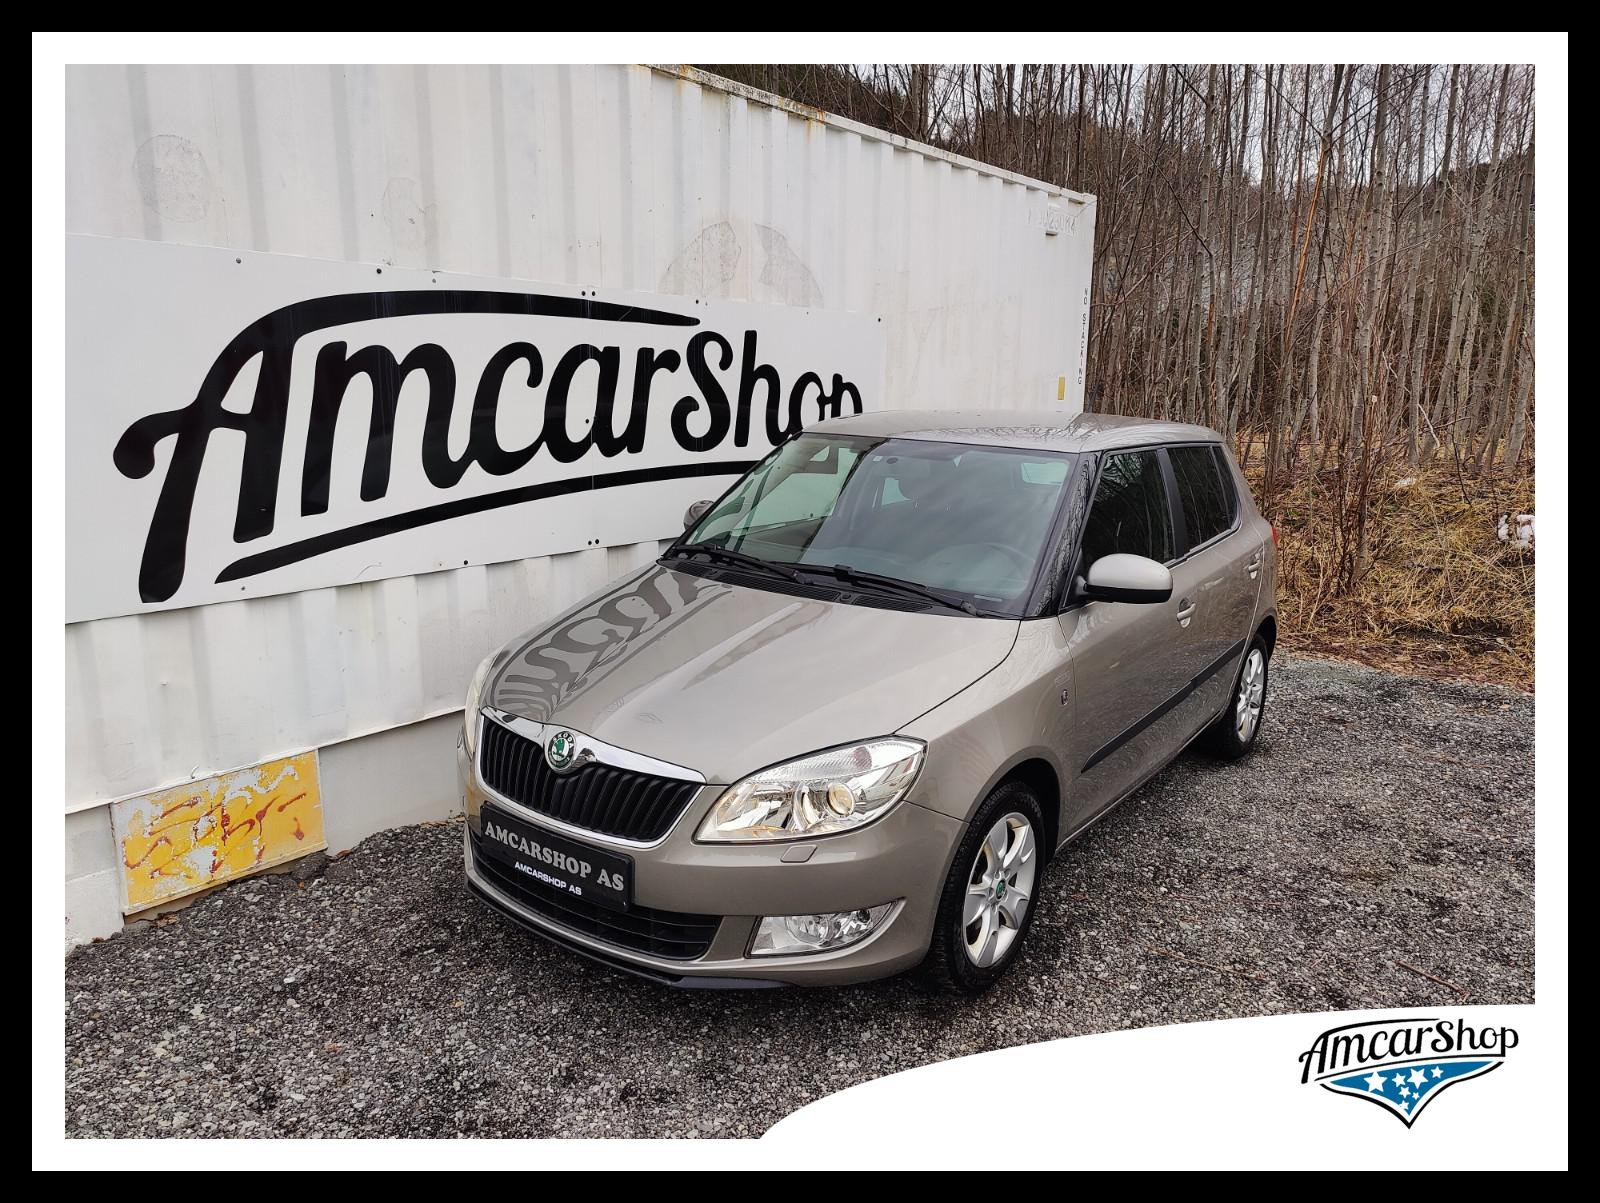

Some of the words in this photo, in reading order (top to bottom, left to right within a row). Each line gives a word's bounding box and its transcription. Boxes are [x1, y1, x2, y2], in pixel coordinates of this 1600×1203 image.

[1083, 287, 1089, 305] NO
[1077, 313, 1087, 385] STACKING
[484, 821, 592, 878] AMCARSHOP
[597, 868, 624, 891] AS
[514, 861, 567, 888] AMCARSHOP
[568, 884, 582, 896] AS
